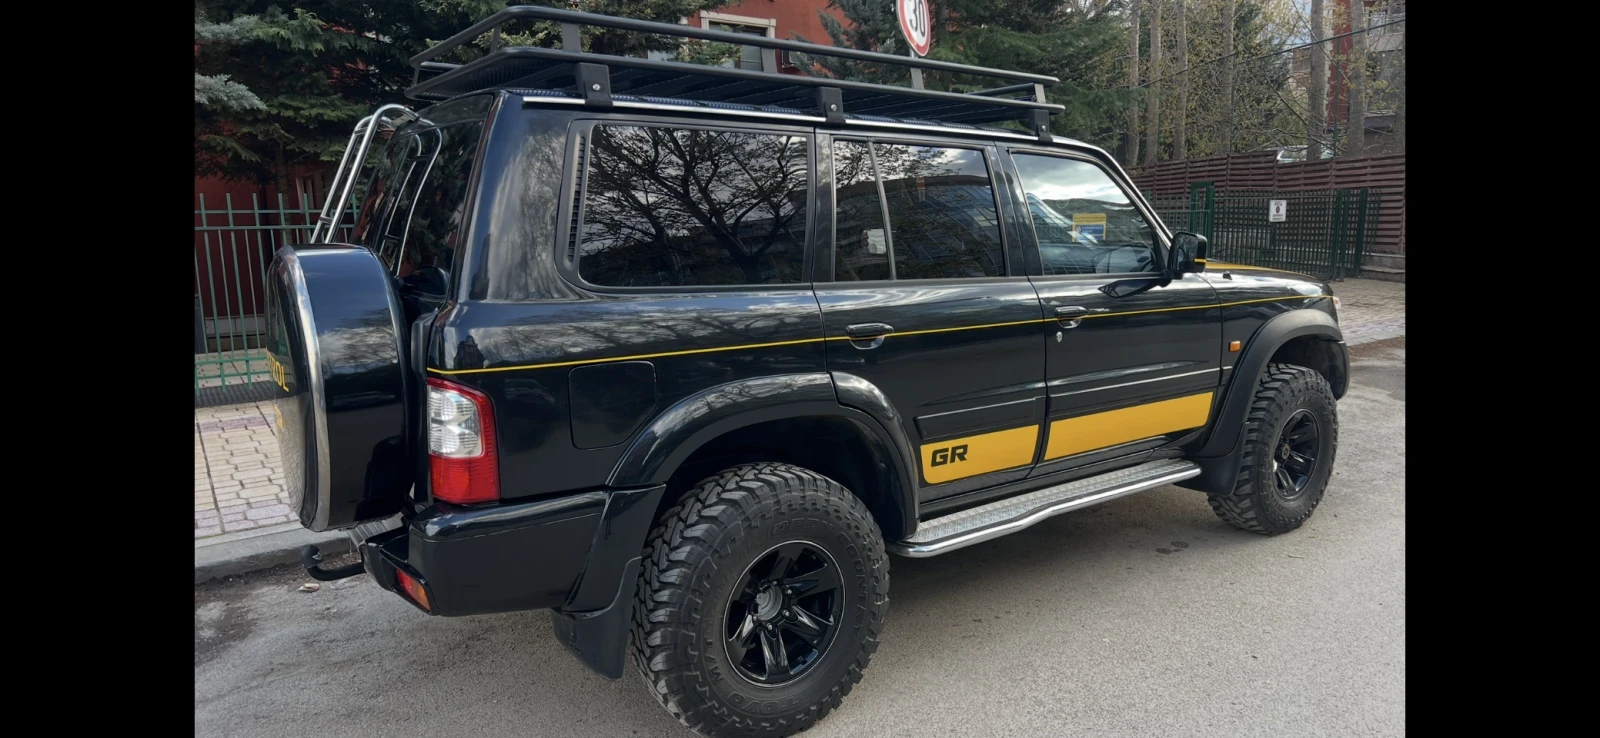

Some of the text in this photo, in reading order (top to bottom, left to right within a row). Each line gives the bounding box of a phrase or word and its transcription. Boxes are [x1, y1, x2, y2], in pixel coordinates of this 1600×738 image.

[909, 0, 926, 37] 30
[931, 444, 968, 467] GR
[771, 517, 868, 640] OPEN COUNTRY
[728, 690, 800, 716] TOYO
